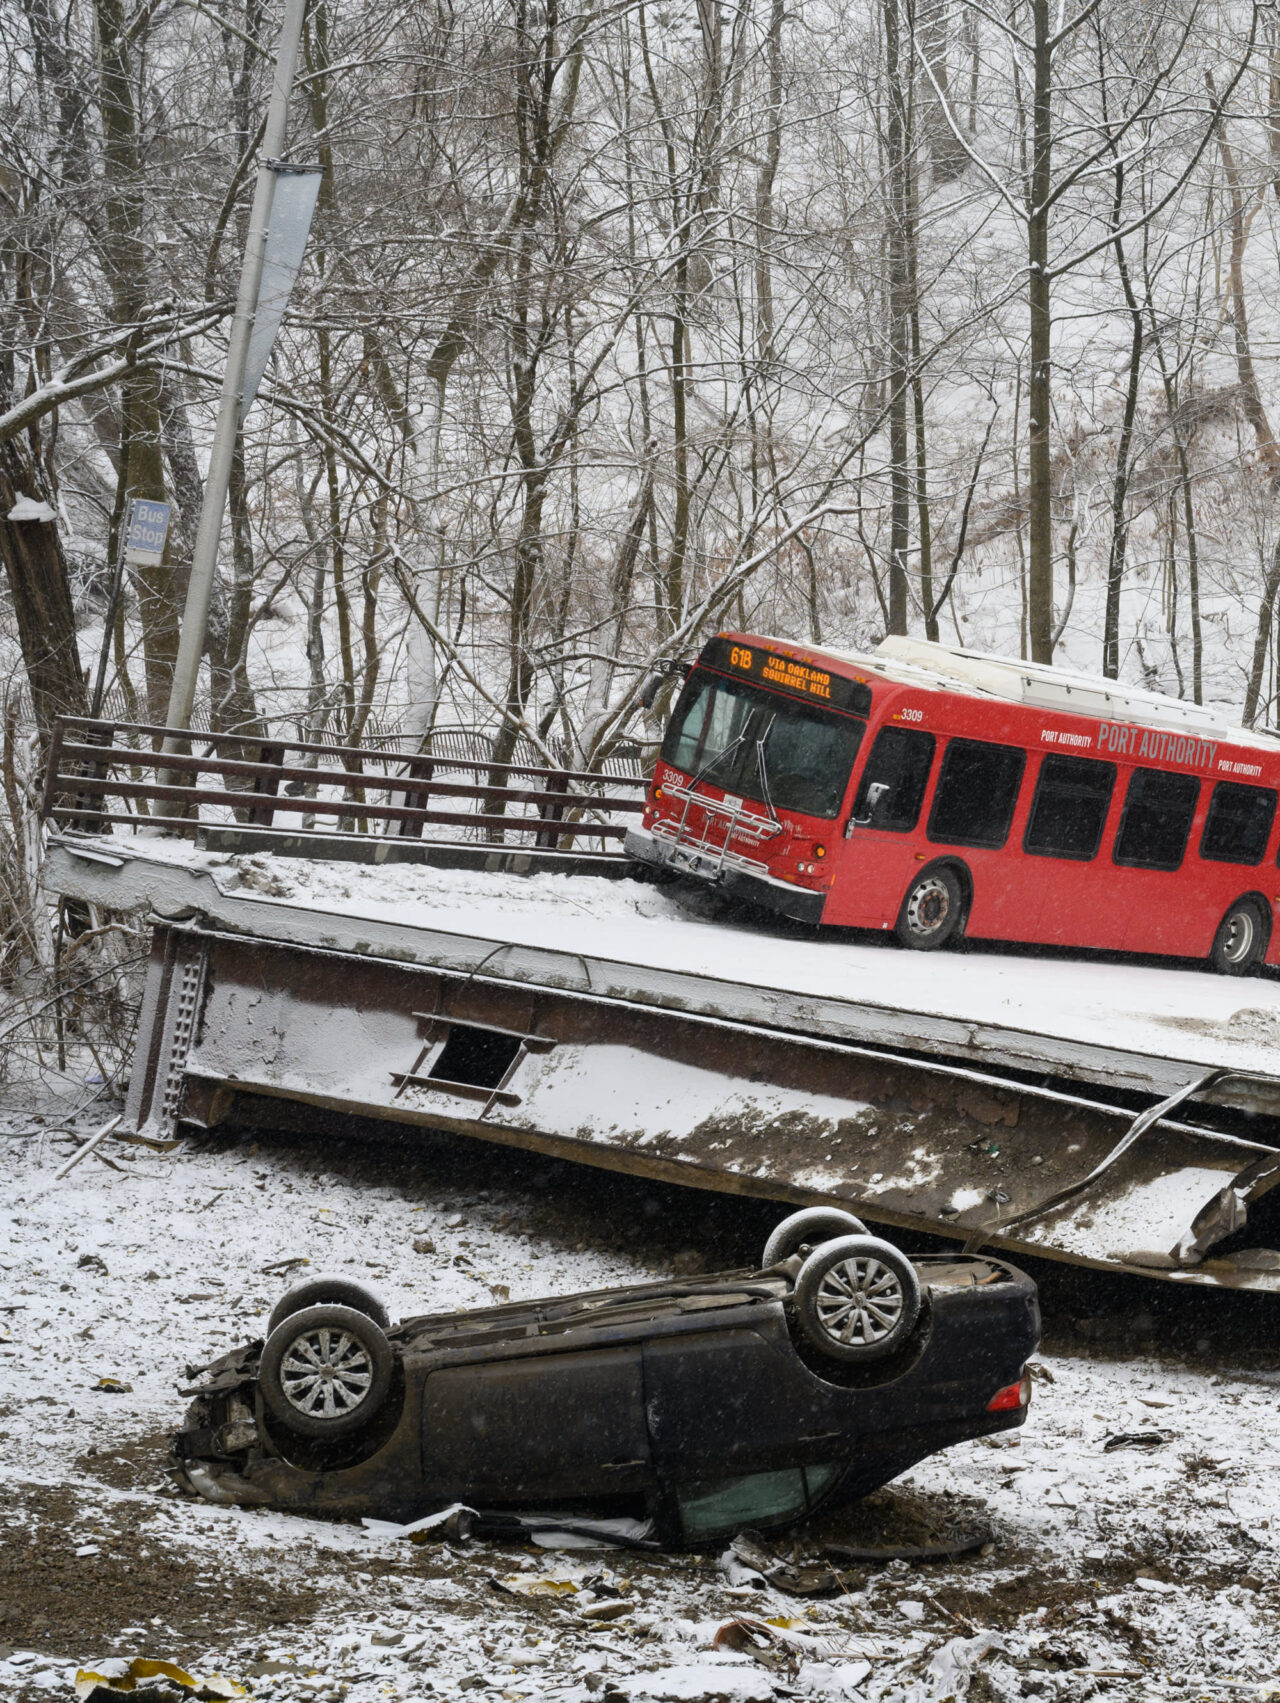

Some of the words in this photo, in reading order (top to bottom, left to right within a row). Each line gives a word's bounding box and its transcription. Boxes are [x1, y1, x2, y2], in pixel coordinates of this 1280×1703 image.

[138, 505, 164, 523] Bus
[131, 524, 163, 546] Stop
[730, 646, 753, 670] 61B
[768, 656, 786, 671] VIA
[787, 663, 831, 686] OAKLAND
[762, 667, 807, 690] SQUIRREL
[809, 682, 832, 699] HILL
[901, 708, 923, 722] 3309
[1041, 729, 1058, 743] PORT
[1058, 732, 1092, 749] AUTHORITY
[1097, 723, 1138, 756] PORT
[1138, 731, 1218, 769] AUTHORITY
[662, 768, 684, 786] 3309
[1217, 759, 1233, 772] PORT
[1233, 763, 1263, 777] AUTHORITY
[738, 836, 760, 848] AUTHORITY
